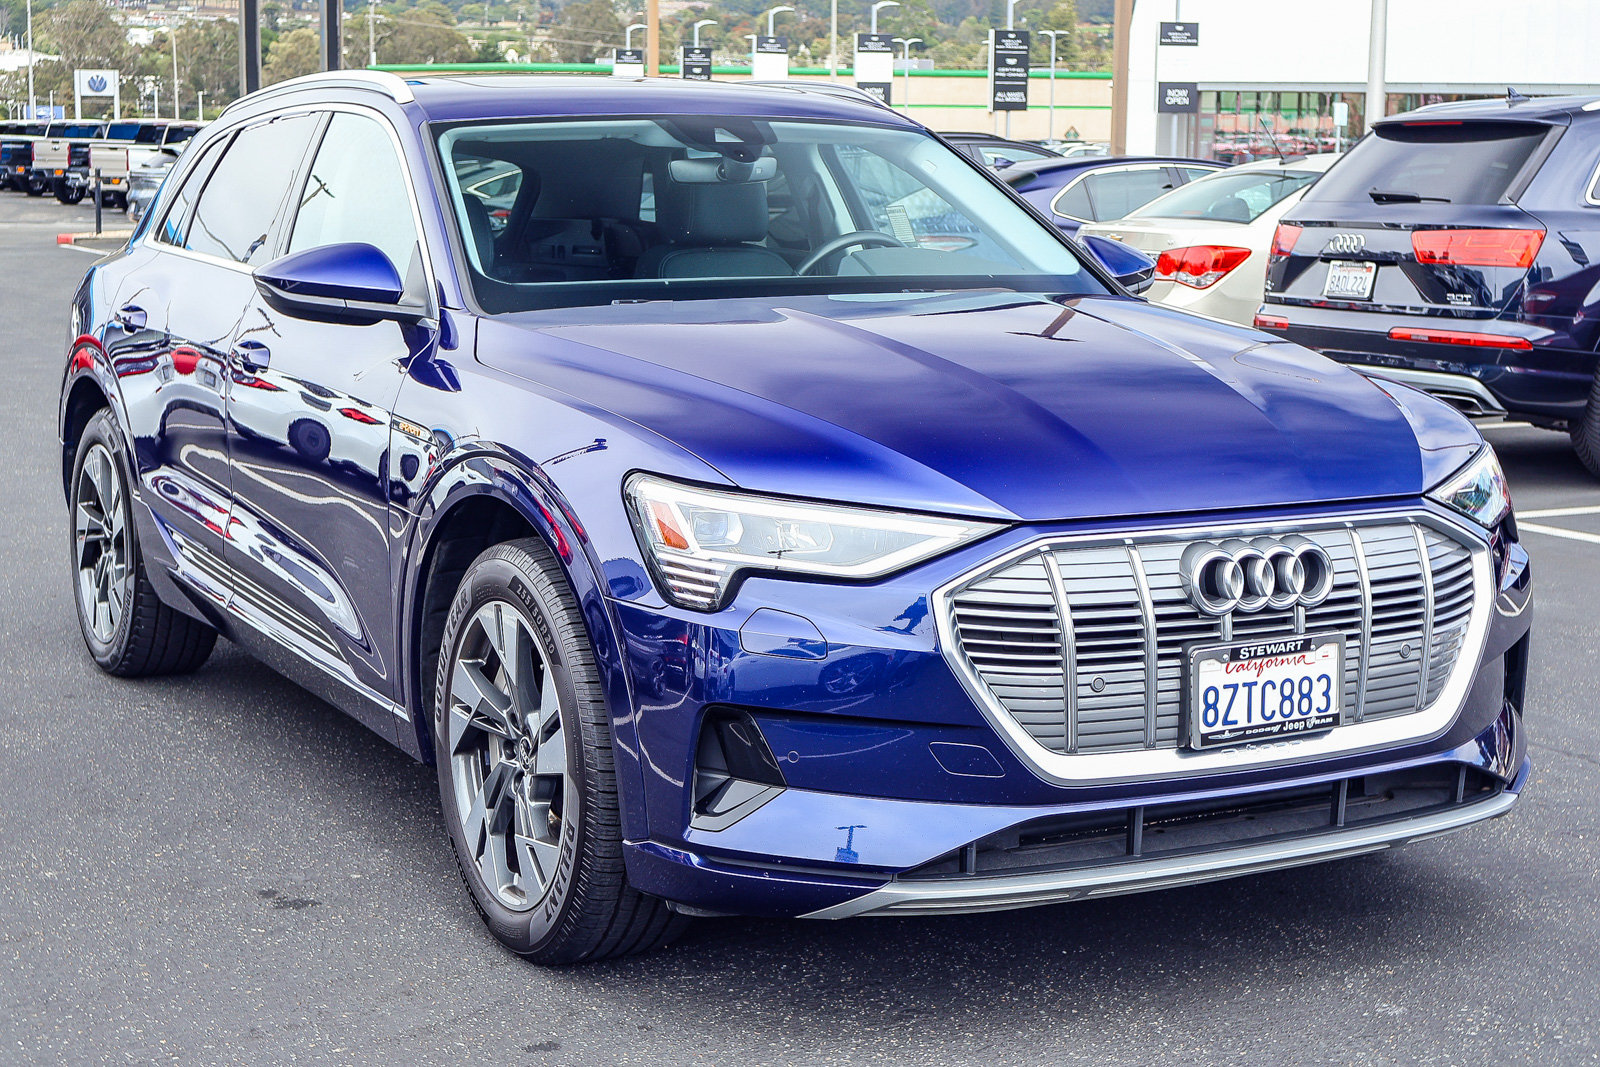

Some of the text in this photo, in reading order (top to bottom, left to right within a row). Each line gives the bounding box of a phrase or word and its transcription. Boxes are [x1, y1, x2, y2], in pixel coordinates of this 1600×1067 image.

[1165, 96, 1190, 105] OPEN
[1166, 88, 1189, 97] NOW
[516, 584, 555, 654] 255/50R20
[1239, 640, 1304, 660] STEWART
[1224, 653, 1316, 678] California
[1202, 673, 1332, 728] 8ZTC883
[1282, 720, 1305, 732] Jeep
